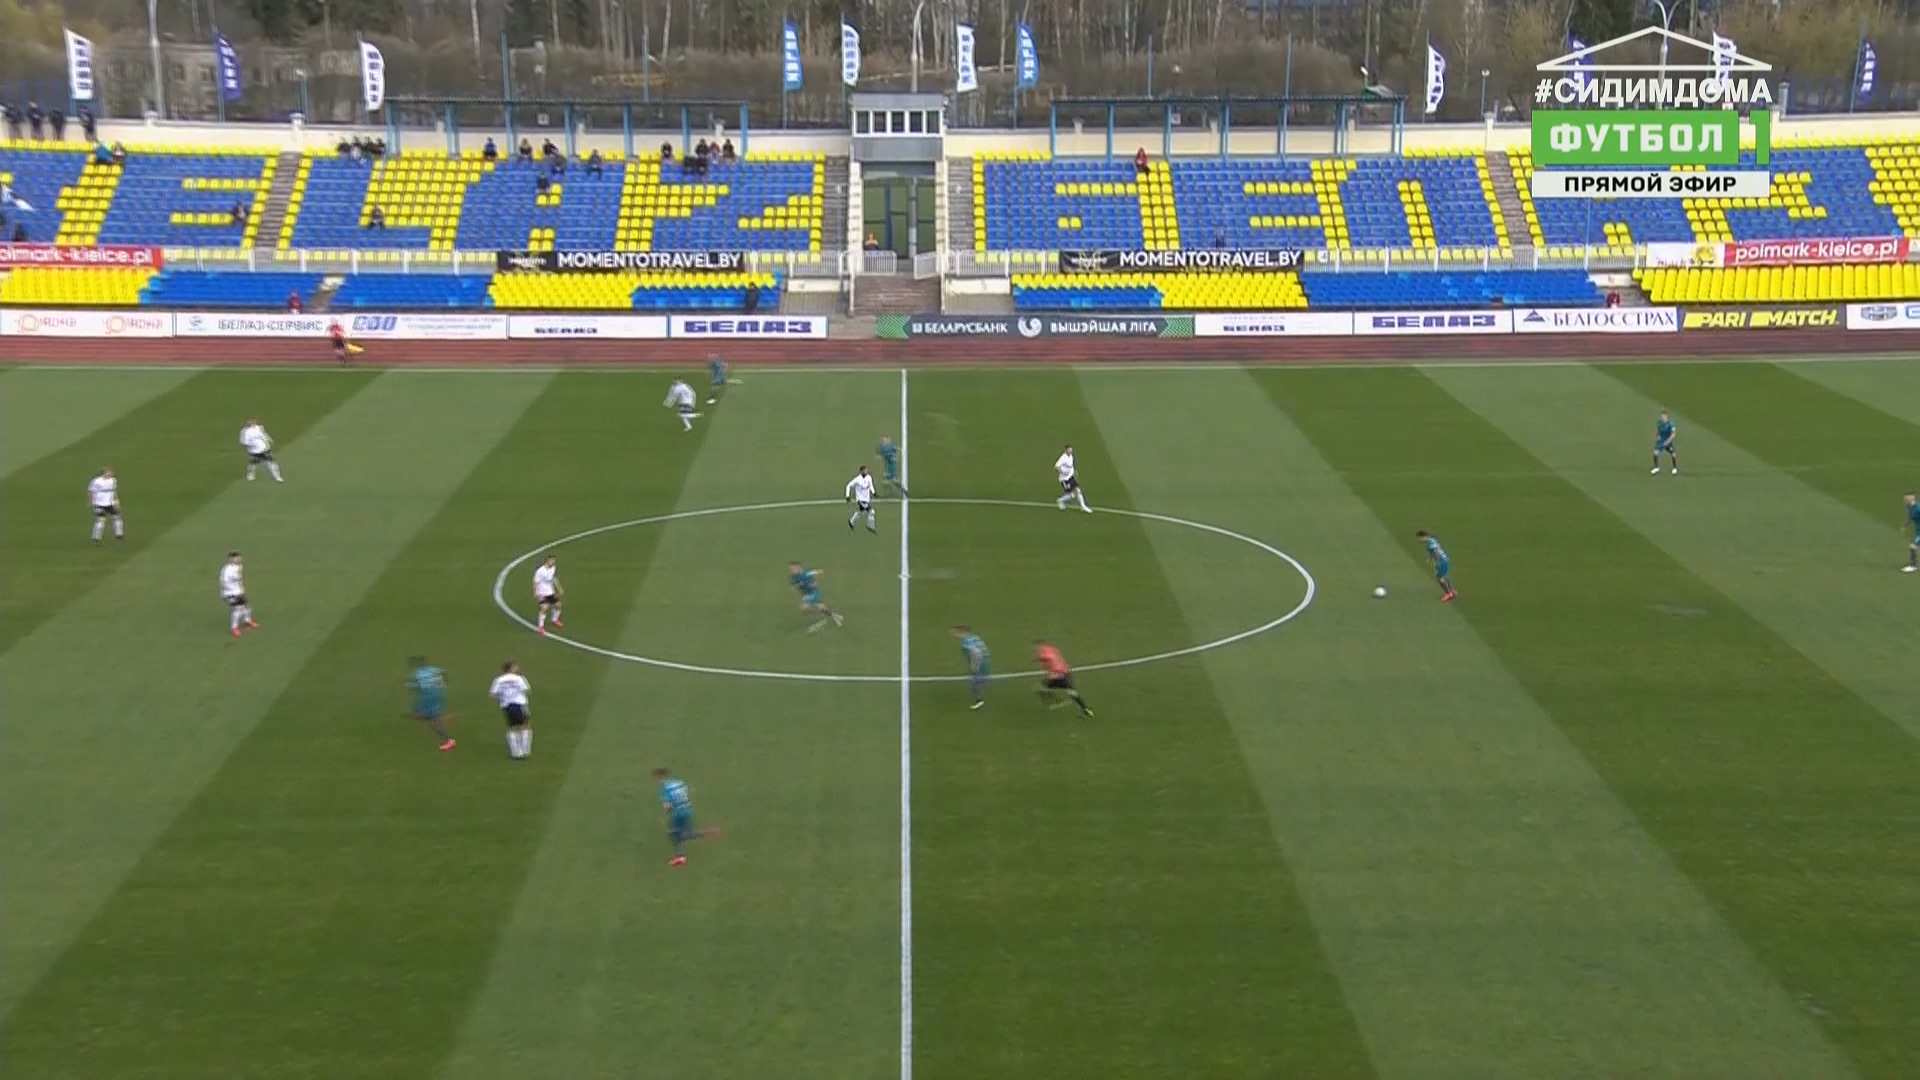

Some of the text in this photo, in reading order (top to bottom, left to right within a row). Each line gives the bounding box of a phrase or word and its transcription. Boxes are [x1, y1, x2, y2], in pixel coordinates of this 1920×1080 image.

[1734, 239, 1898, 262] polmark-kielce.pl
[556, 251, 741, 268] MOMENTOTRAVEL.BY
[1119, 250, 1301, 267] MOMENTOTRAVEL.BY
[1050, 319, 1127, 333] ВЫШЭЙШАЯ
[1372, 315, 1495, 328] БЕЛАЗ
[1553, 312, 1675, 326] БЕЛГОССТРАХ
[1690, 309, 1838, 328] PARI MATCH
[684, 320, 812, 333] БЕЛАЗ
